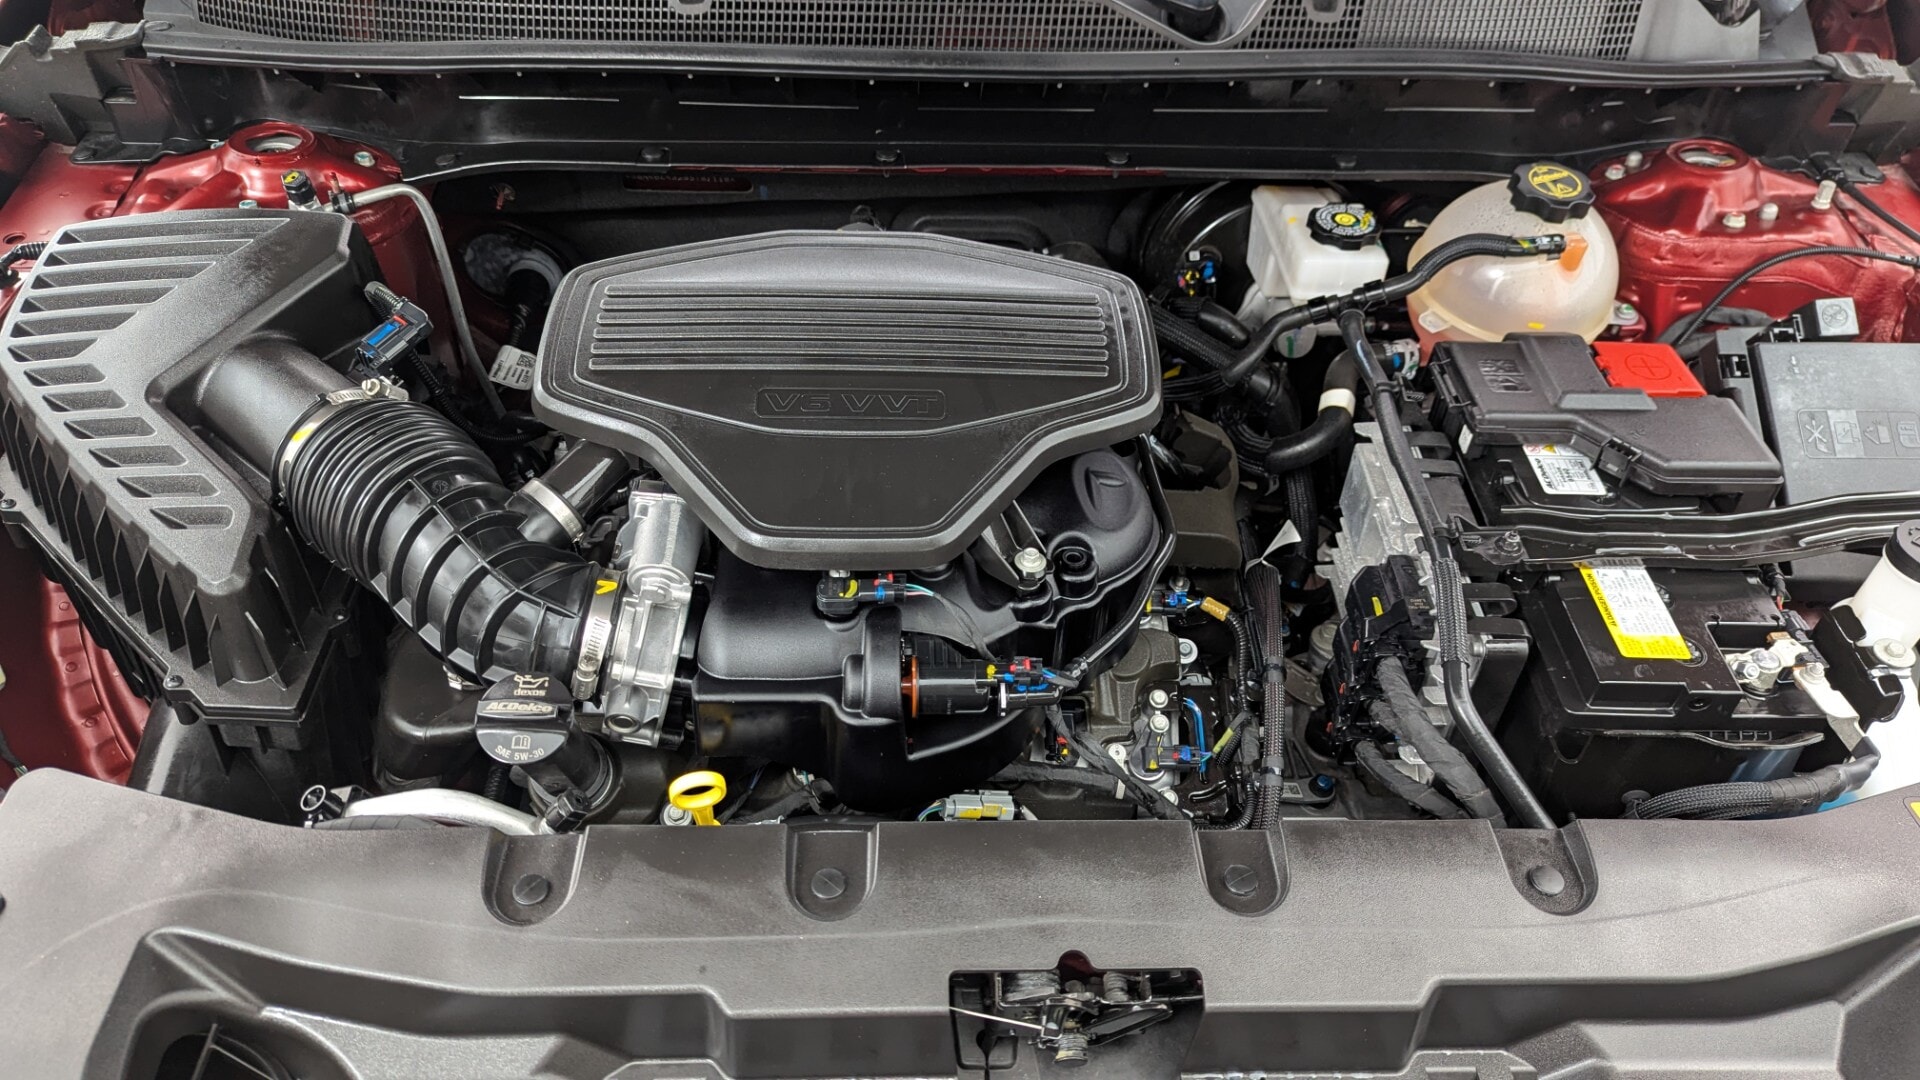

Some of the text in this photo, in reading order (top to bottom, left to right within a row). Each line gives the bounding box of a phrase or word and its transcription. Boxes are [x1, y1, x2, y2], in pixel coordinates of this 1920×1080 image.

[765, 393, 938, 413] V6 VVT
[514, 688, 547, 697] dexos
[485, 702, 553, 712] ACDelco
[495, 744, 545, 761] SAE 5W-30
